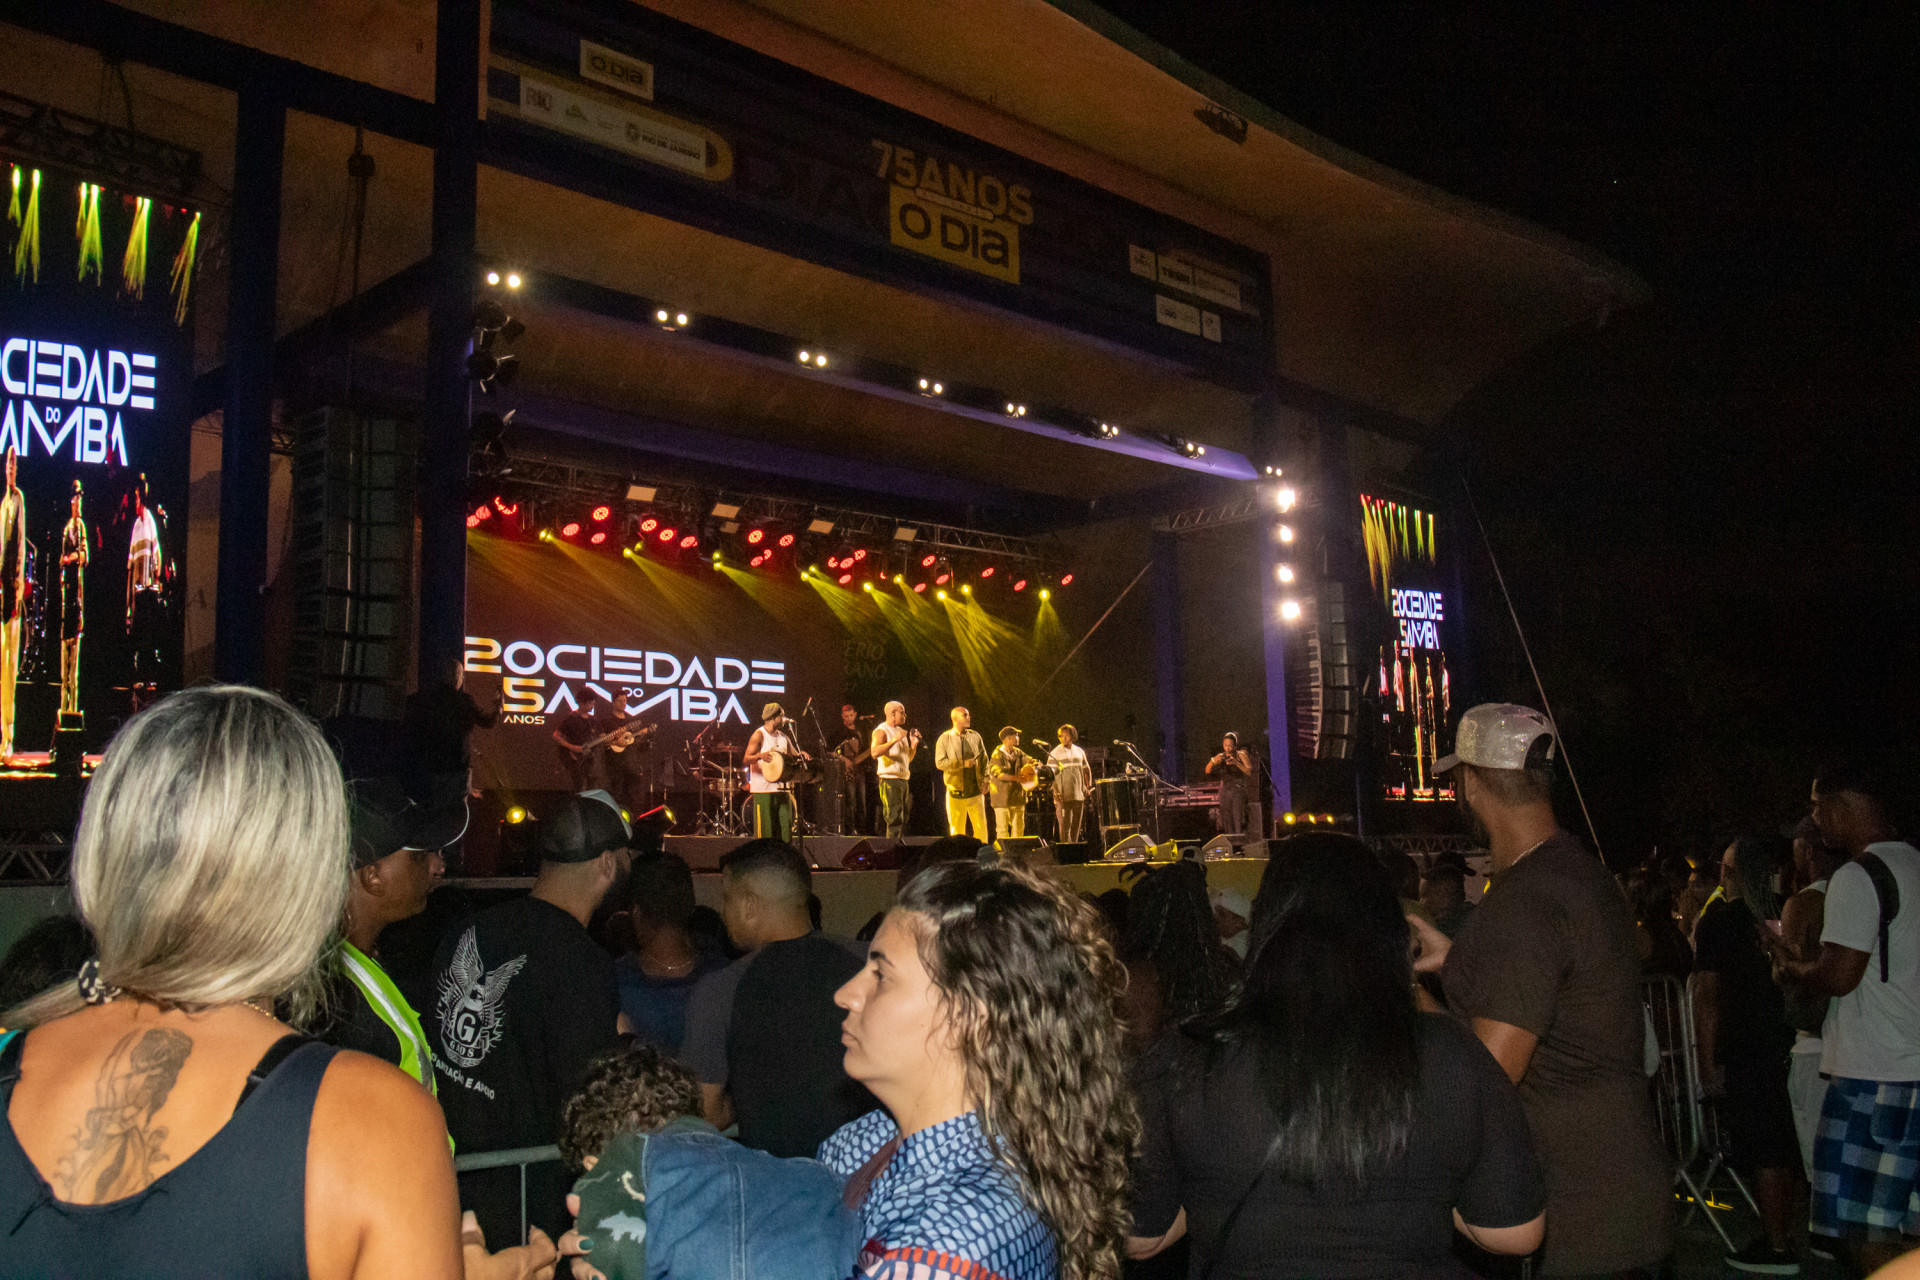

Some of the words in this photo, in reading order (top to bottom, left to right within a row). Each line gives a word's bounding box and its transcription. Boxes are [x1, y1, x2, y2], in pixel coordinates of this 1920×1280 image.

[590, 55, 606, 72] O
[899, 203, 931, 241] O
[0, 337, 156, 410] CIEDADE
[45, 406, 61, 424] DO
[0, 399, 129, 467] AMBA
[503, 714, 545, 725] ANOS
[456, 1012, 477, 1043] G
[464, 1077, 474, 1089] E
